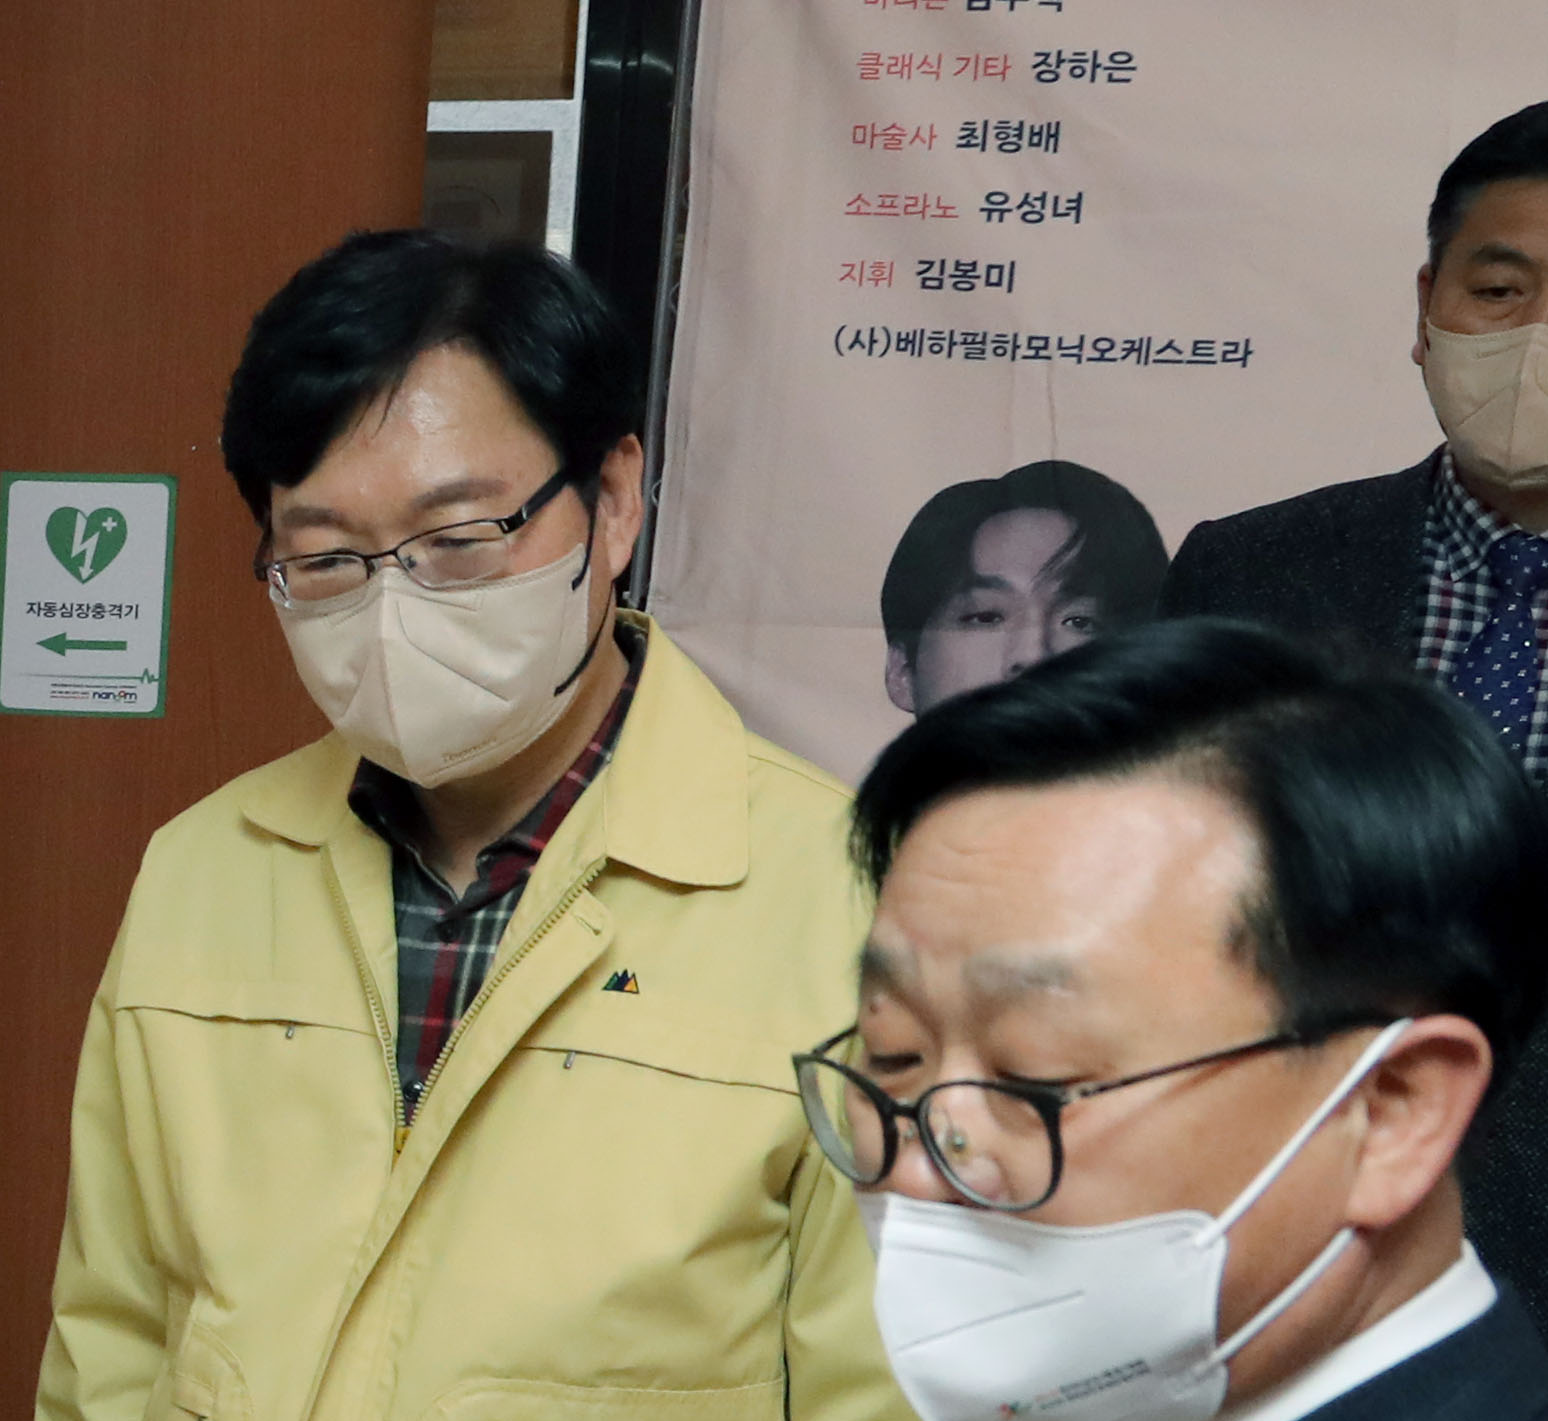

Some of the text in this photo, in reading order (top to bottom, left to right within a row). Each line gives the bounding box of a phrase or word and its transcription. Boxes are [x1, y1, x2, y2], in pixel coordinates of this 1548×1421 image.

[856, 49, 1138, 84] 클래식 기타 장하은
[851, 119, 1062, 154] 마술사 최형배
[844, 190, 1084, 225] 소프라노 유성녀
[837, 258, 1017, 294] 지휘 김봉미
[833, 324, 1254, 368] (사)베하필하모닉오케스트라
[25, 601, 140, 620] 자동심장충격기
